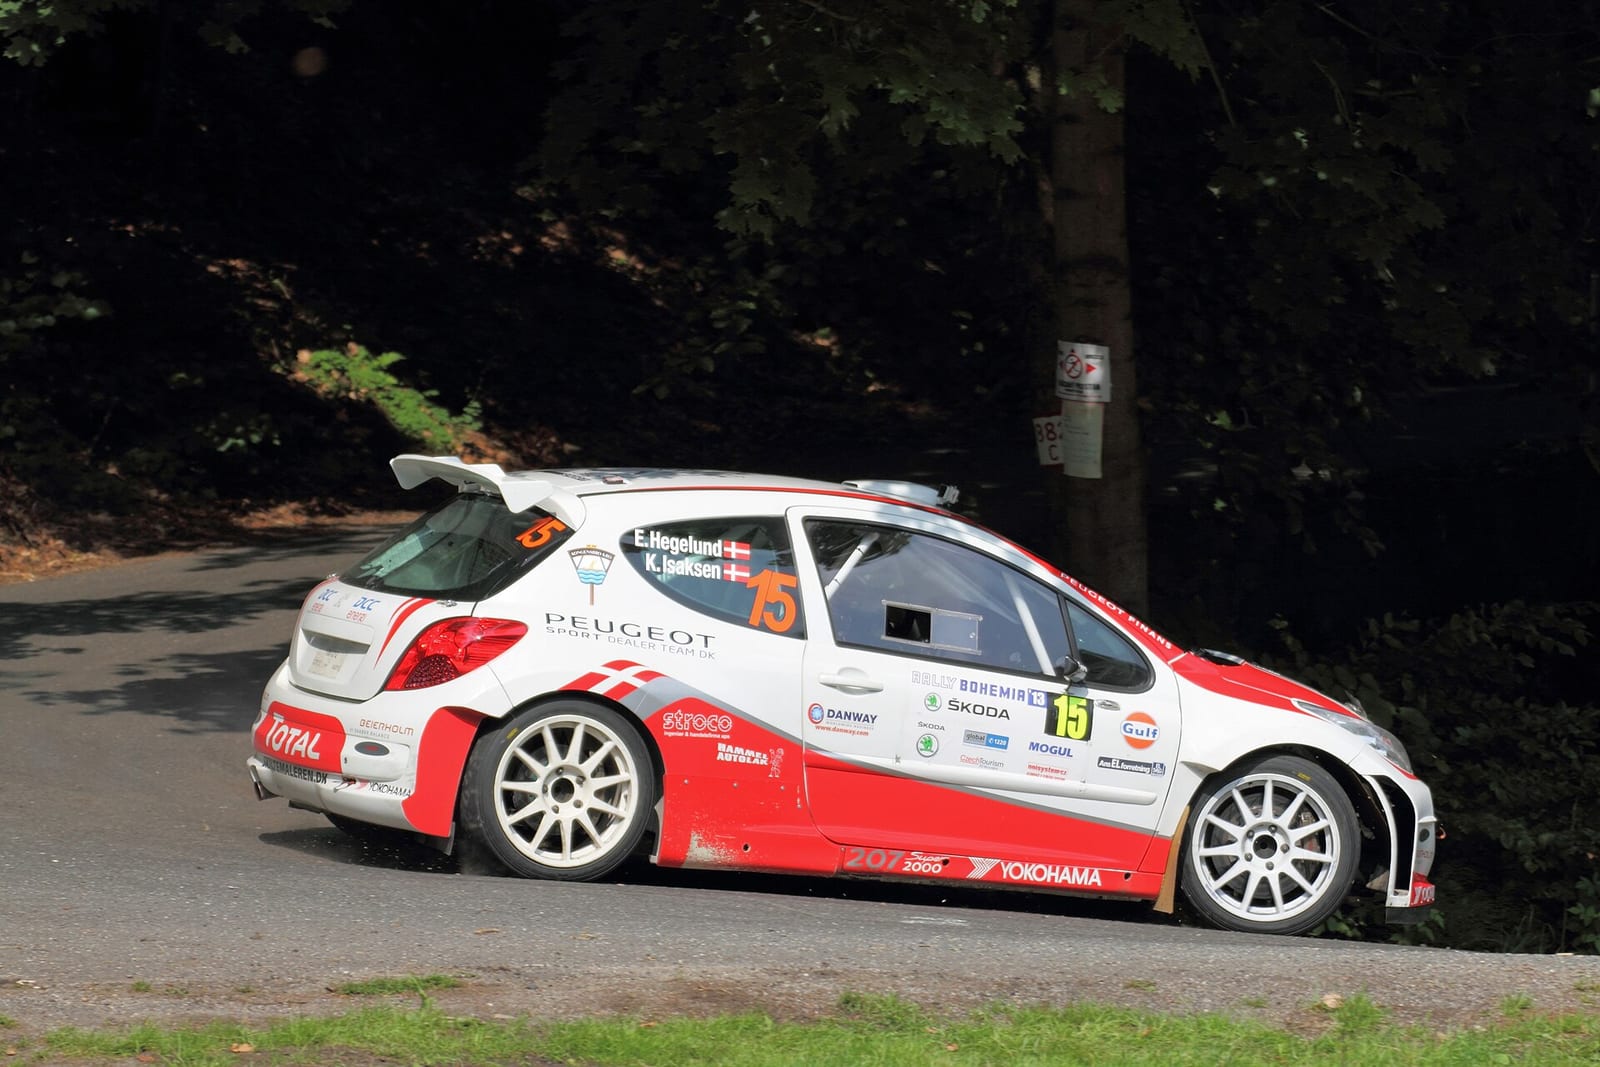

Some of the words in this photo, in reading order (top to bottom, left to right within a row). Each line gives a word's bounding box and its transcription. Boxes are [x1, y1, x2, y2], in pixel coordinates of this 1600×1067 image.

[1048, 444, 1059, 461] C
[515, 516, 567, 549] 15
[353, 596, 382, 611] DCC
[746, 569, 798, 633] 15
[1060, 572, 1126, 616] PEUGEOT
[1128, 615, 1172, 650] FINANS
[545, 613, 716, 649] PEUGEOT
[546, 626, 601, 641] SPORT
[608, 635, 656, 651] DEALER
[661, 644, 695, 657] TEAM
[699, 650, 716, 660] DK
[911, 670, 957, 690] RALLY
[959, 679, 1026, 702] BOHEMIA
[826, 708, 878, 725] DANWAY
[948, 698, 1010, 721] ŠKODA
[1053, 693, 1089, 741] 15
[359, 719, 414, 737] BEIERHOLM
[663, 709, 732, 733] stroco
[917, 721, 945, 732] ŠKODA
[265, 712, 321, 760] TOTAL
[815, 724, 869, 737] www.danway.com
[965, 732, 985, 742] global
[1122, 722, 1158, 740] Gulf
[716, 751, 769, 766] AUTOLAK
[717, 742, 769, 760] HAMMEL
[1028, 741, 1073, 758] MOGUL
[1111, 759, 1121, 769] EL
[369, 781, 411, 798] YOKOHAMA
[846, 849, 905, 871] 207
[902, 861, 943, 874] 2000
[1000, 860, 1102, 886] YOKOHAMA
